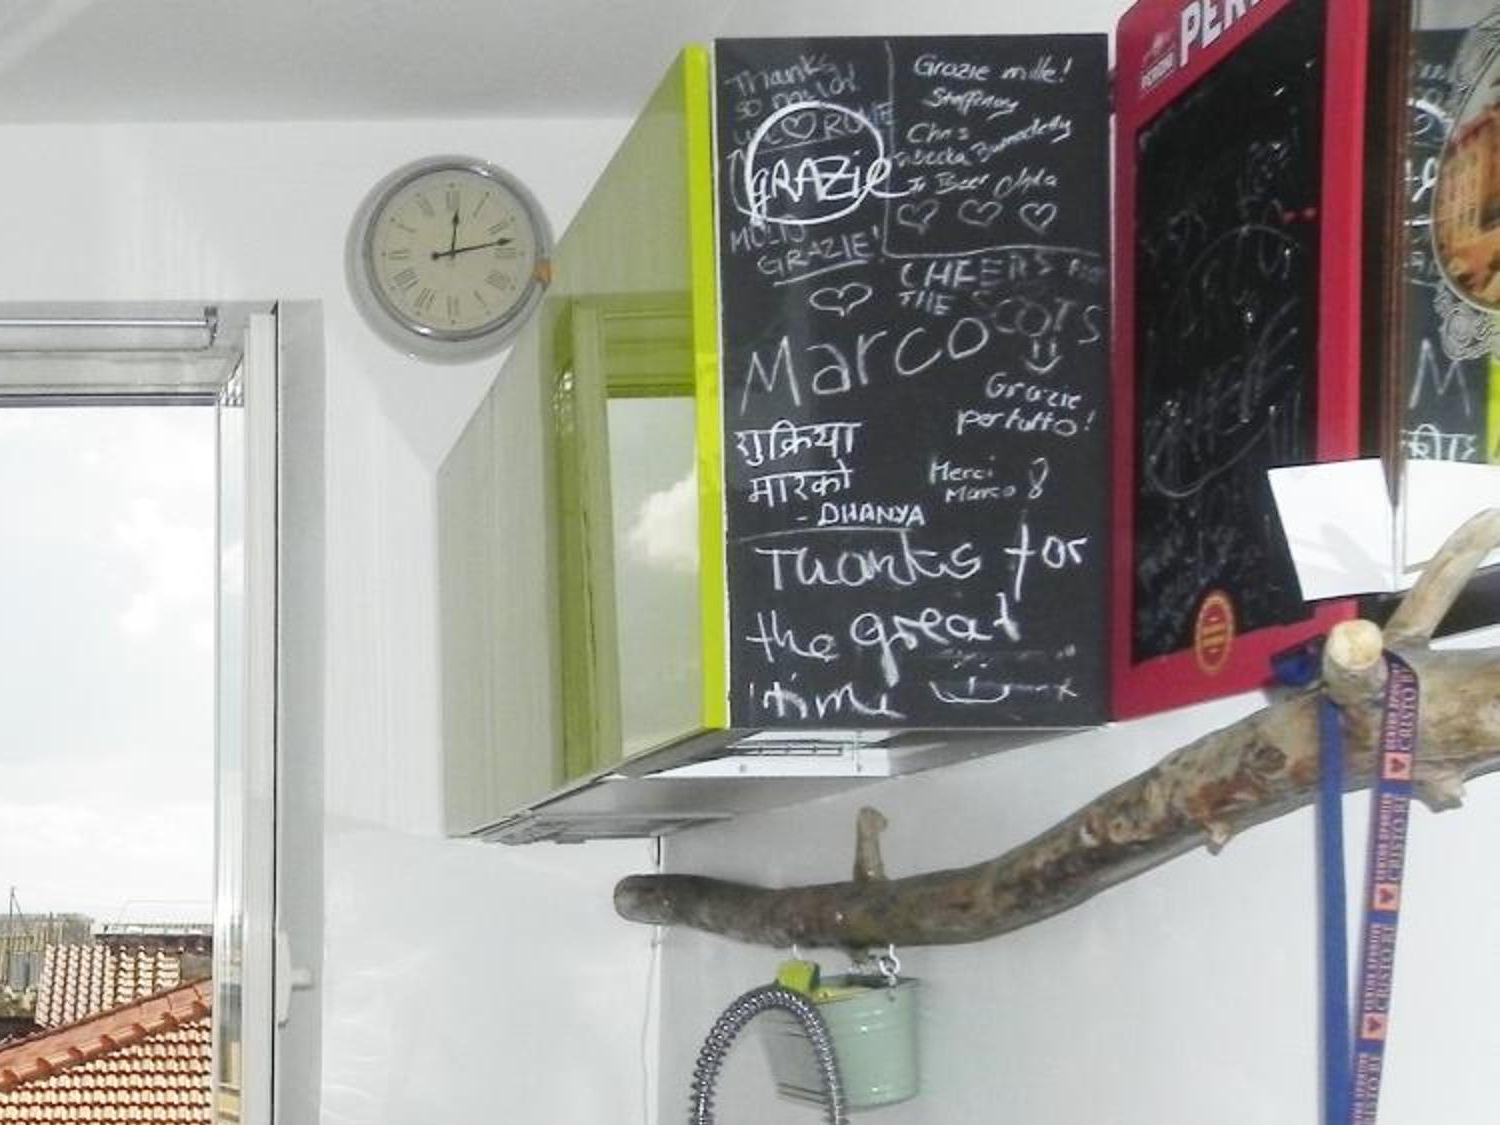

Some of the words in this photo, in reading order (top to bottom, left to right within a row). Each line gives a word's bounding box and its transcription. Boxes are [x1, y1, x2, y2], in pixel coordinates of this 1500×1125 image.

[1180, 0, 1262, 68] PER
[724, 53, 839, 98] Thanks
[913, 54, 991, 81] Grazie
[739, 316, 989, 416] Marco
[929, 455, 993, 484] Merci
[817, 502, 926, 527] DHANYA
[746, 610, 840, 663] the
